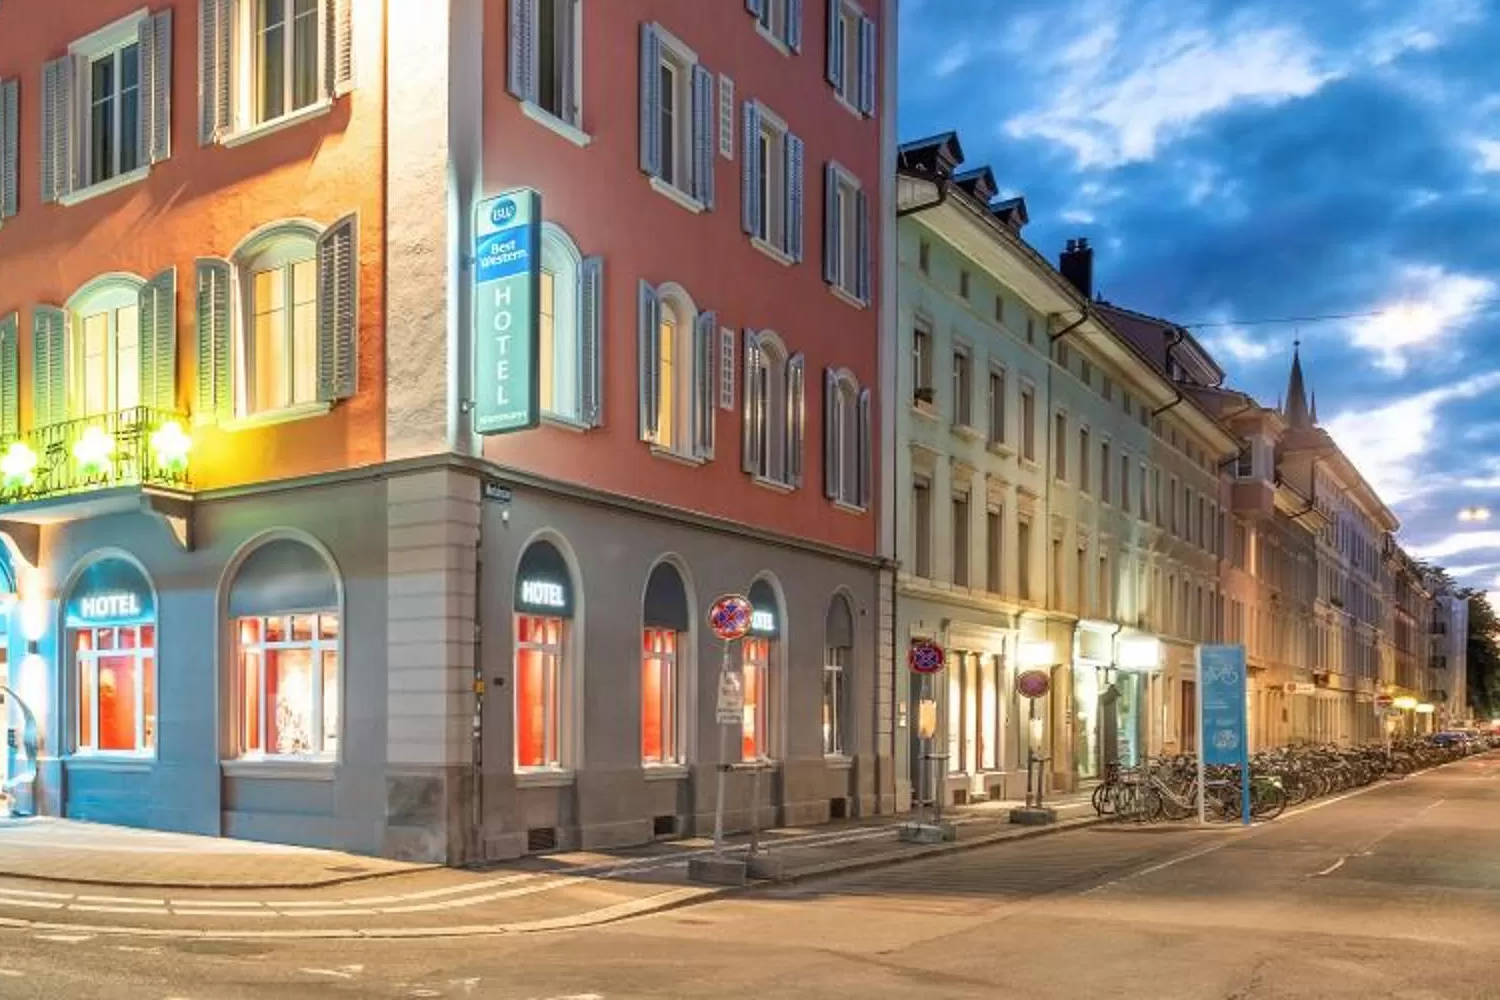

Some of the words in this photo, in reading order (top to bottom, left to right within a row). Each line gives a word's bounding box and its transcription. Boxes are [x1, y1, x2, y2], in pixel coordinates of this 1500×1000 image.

[491, 240, 516, 254] Best
[494, 286, 512, 405] HOTEL
[82, 592, 141, 617] HOTEL
[522, 579, 565, 607] HOTEL
